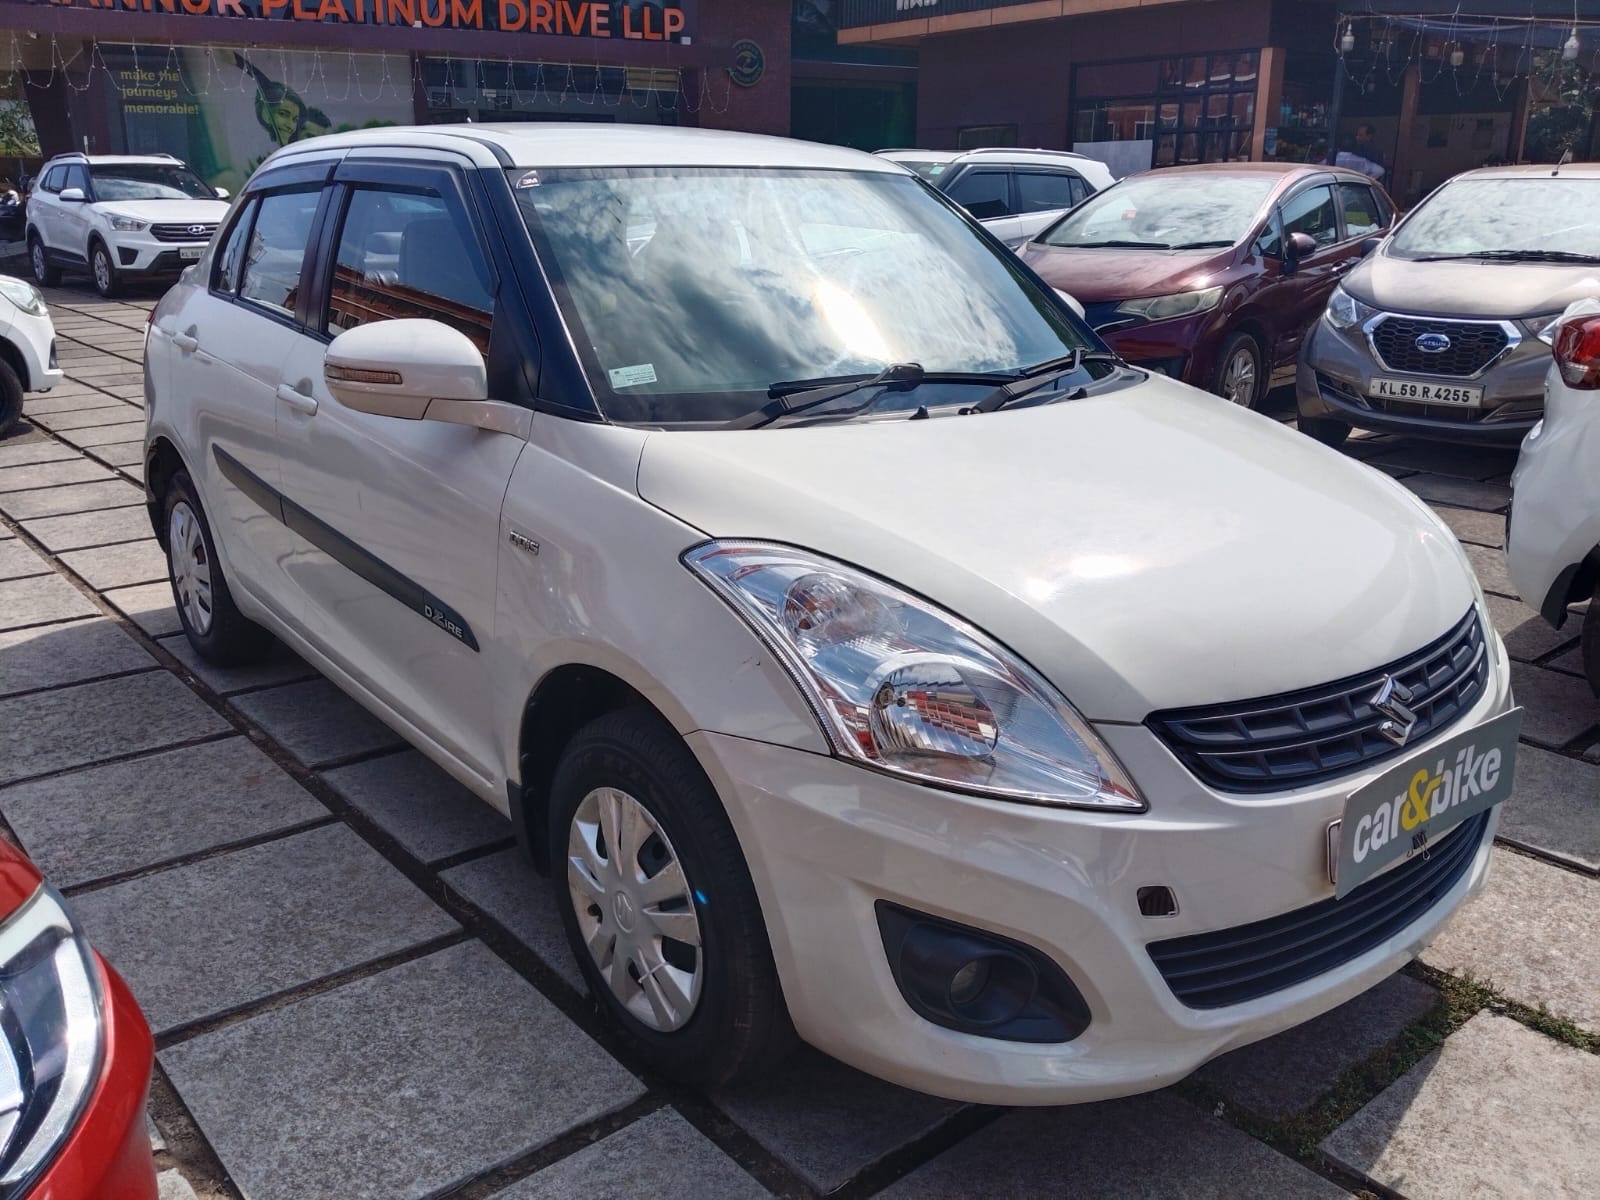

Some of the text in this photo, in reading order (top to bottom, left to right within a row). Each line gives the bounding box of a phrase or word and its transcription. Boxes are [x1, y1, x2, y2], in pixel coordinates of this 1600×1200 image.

[499, 0, 611, 37] DRIVE
[622, 5, 686, 41] LLP
[120, 70, 180, 82] make the
[122, 85, 178, 99] journeys
[123, 103, 199, 115] memorable!
[1353, 744, 1502, 863] car&bike
